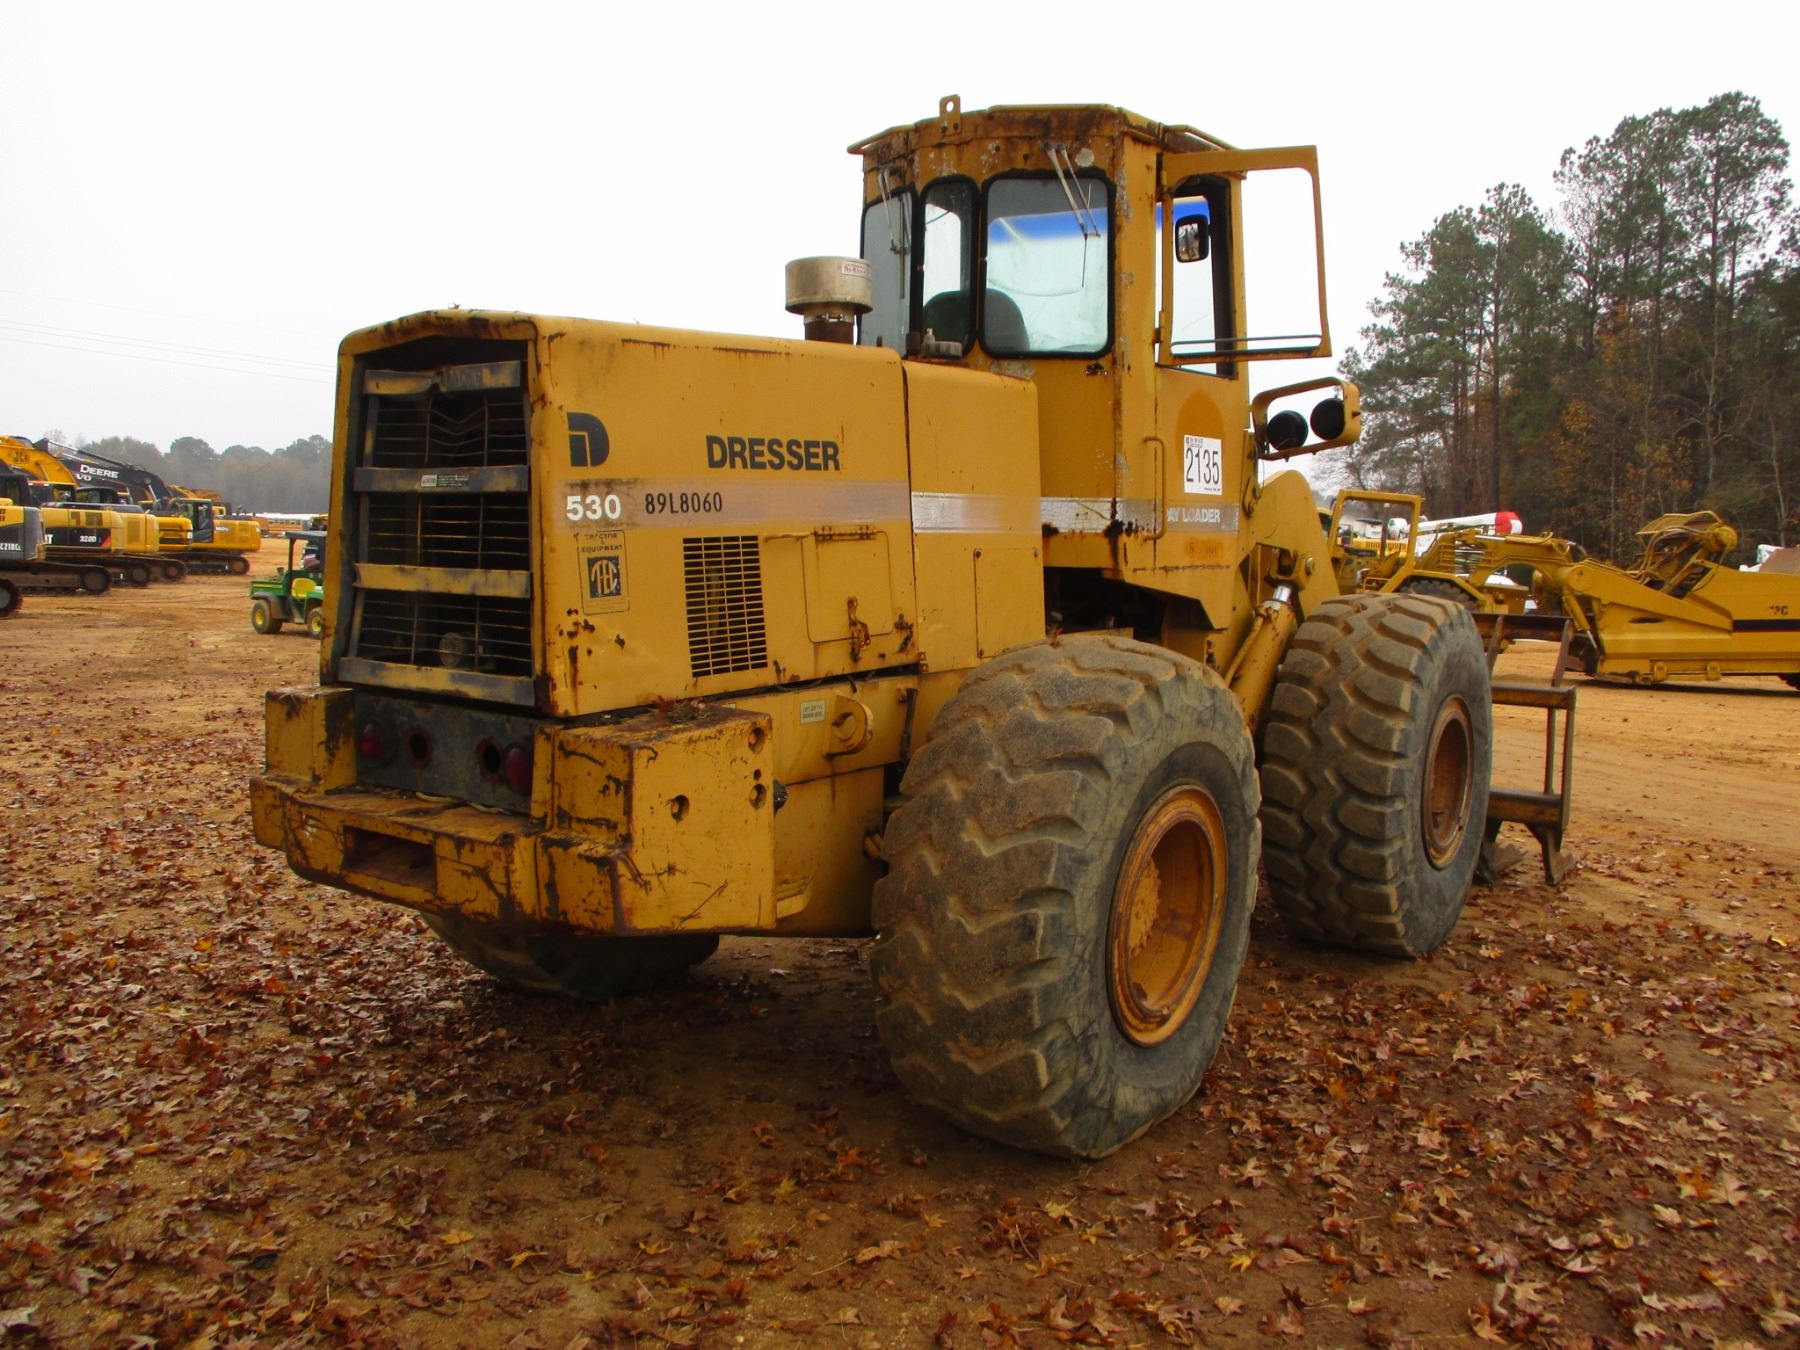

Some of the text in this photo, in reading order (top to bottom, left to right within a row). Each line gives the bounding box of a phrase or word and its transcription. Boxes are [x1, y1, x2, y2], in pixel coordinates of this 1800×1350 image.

[706, 435, 840, 471] DRESSER
[79, 464, 119, 479] DEERE
[1185, 447, 1220, 485] 2135
[565, 494, 622, 521] 530
[645, 491, 723, 515] 89L8060
[1182, 508, 1221, 523] LOADER
[581, 544, 623, 554] EQUIPMENT
